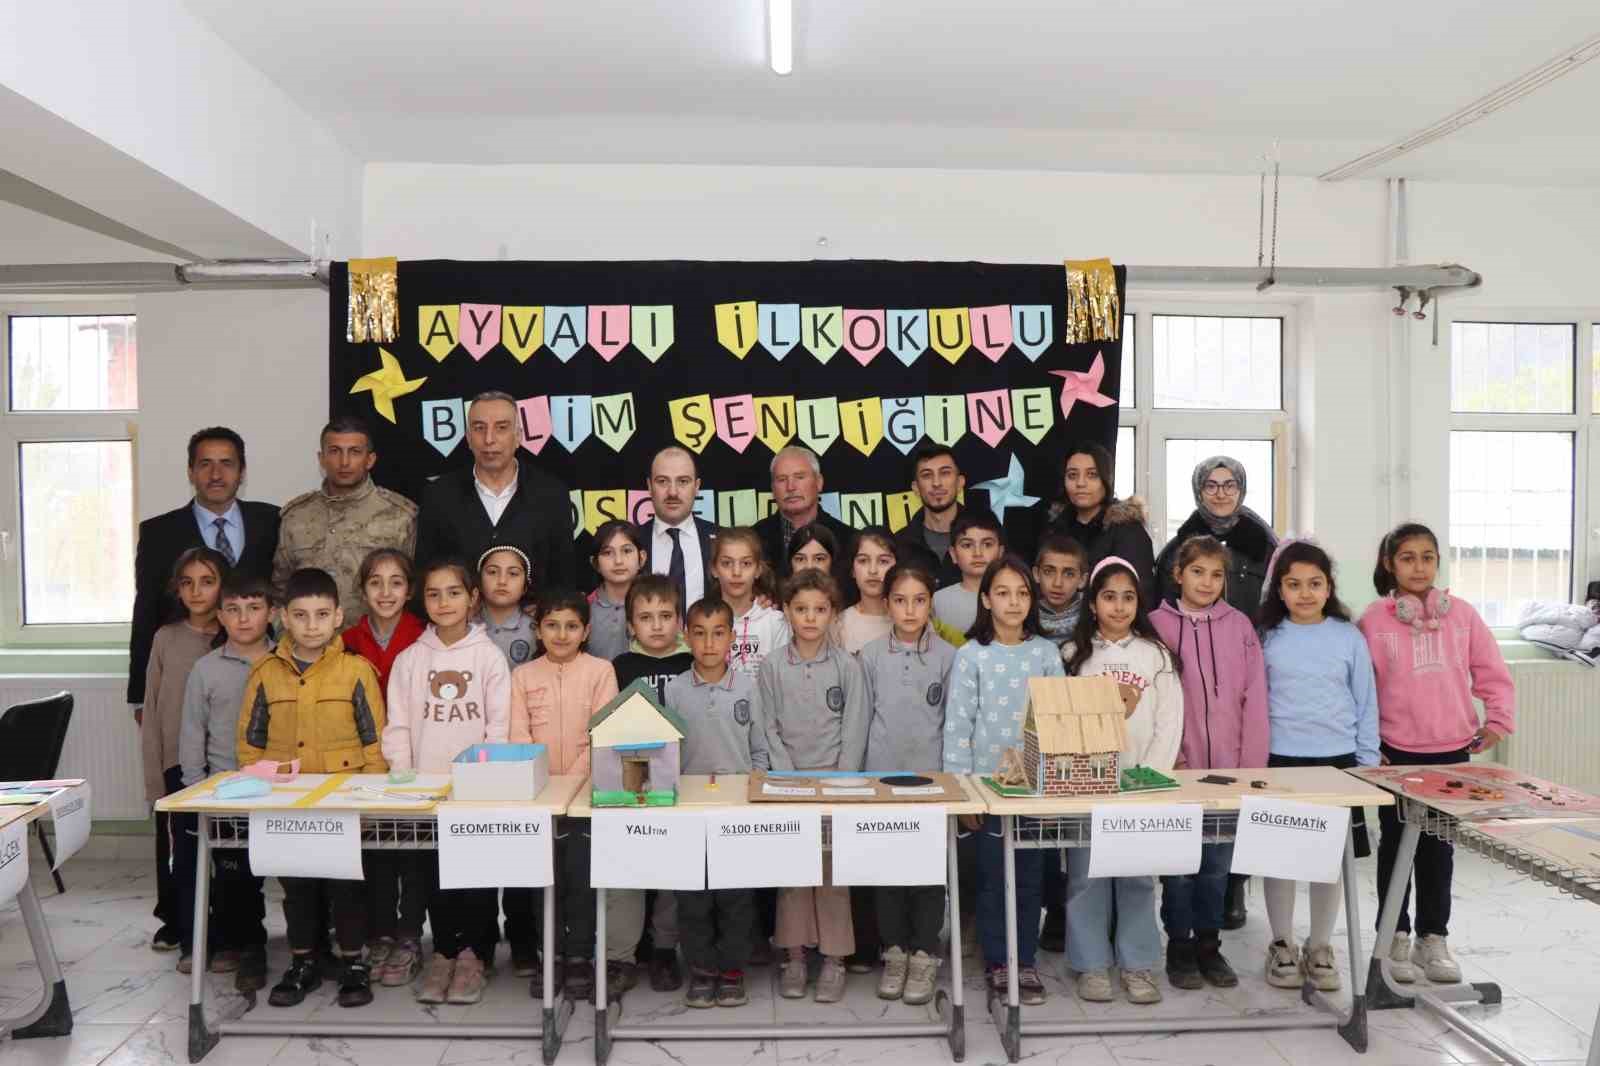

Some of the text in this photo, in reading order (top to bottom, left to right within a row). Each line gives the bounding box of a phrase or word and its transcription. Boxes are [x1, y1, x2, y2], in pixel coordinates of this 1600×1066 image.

[425, 305, 1046, 352] AYVALI İLKOKULU
[432, 391, 1046, 448] BLİM ŞENLİĞİNE
[731, 642, 760, 654] ergy
[265, 817, 344, 833] PRİZMATÖR
[450, 820, 541, 834] GEOMETRİK EV
[856, 820, 920, 832] SAYDAMLIK
[1139, 817, 1193, 832] ŞAHANE
[1250, 810, 1328, 831] GÖLGEMATİK
[721, 824, 751, 834] %100
